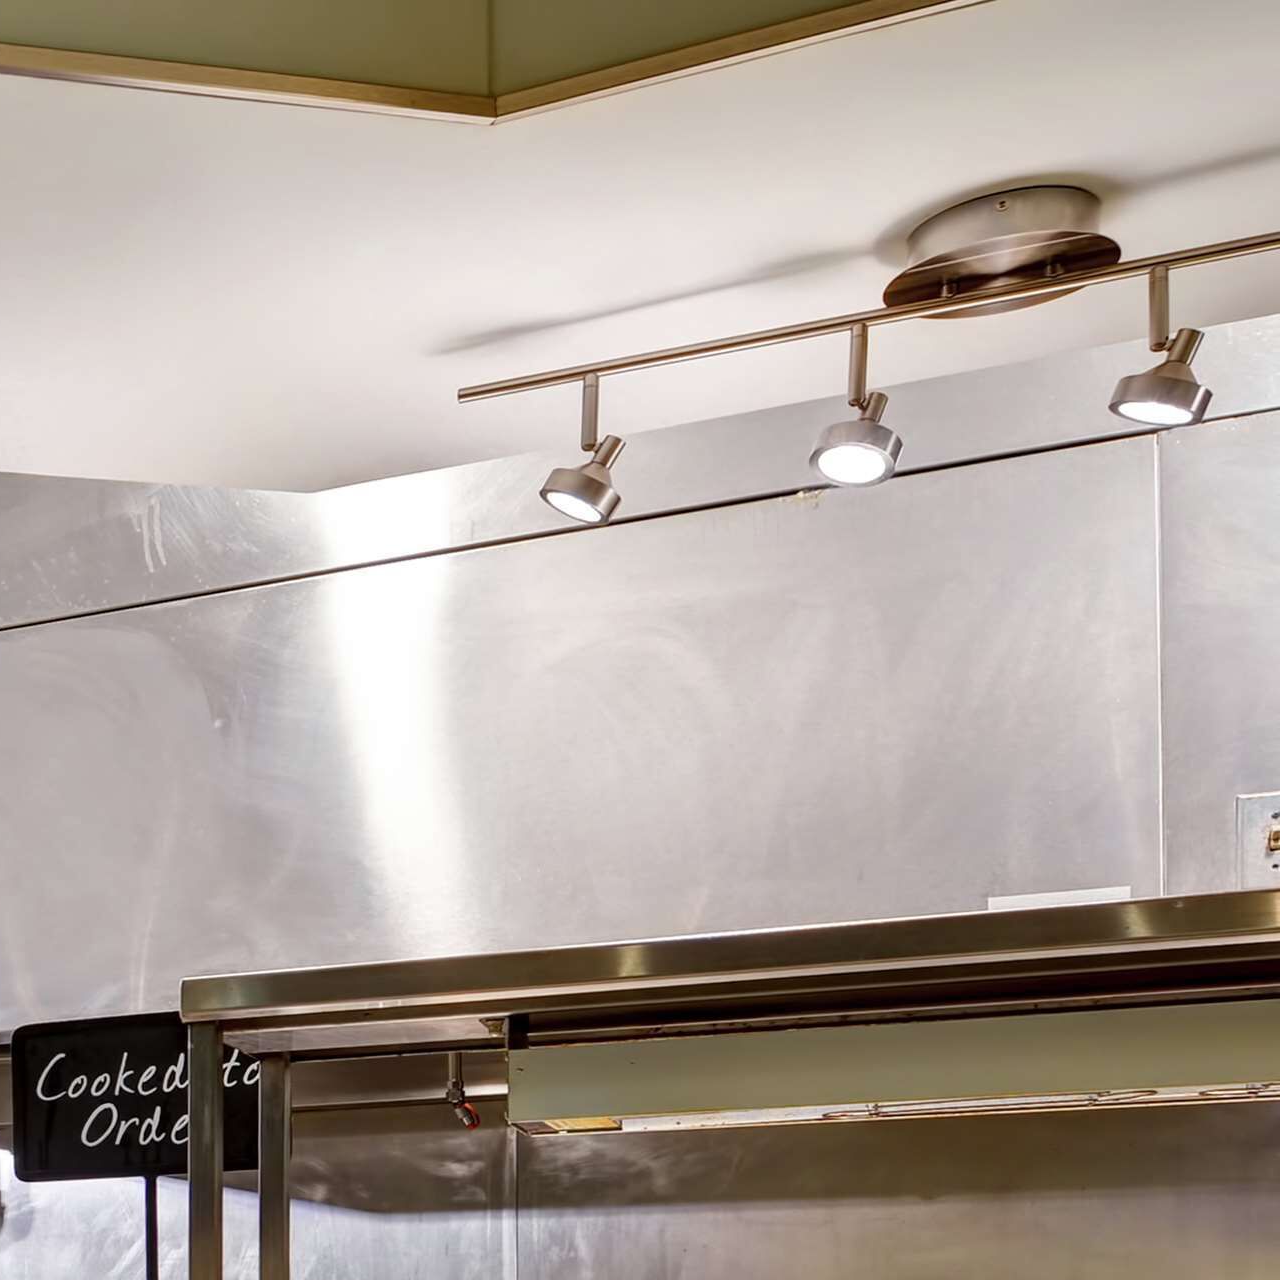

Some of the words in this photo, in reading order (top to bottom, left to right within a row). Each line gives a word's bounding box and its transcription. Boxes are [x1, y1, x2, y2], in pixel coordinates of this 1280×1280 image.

[35, 1051, 190, 1101] Cooked
[222, 1048, 261, 1088] to
[80, 1102, 190, 1148] Orde
